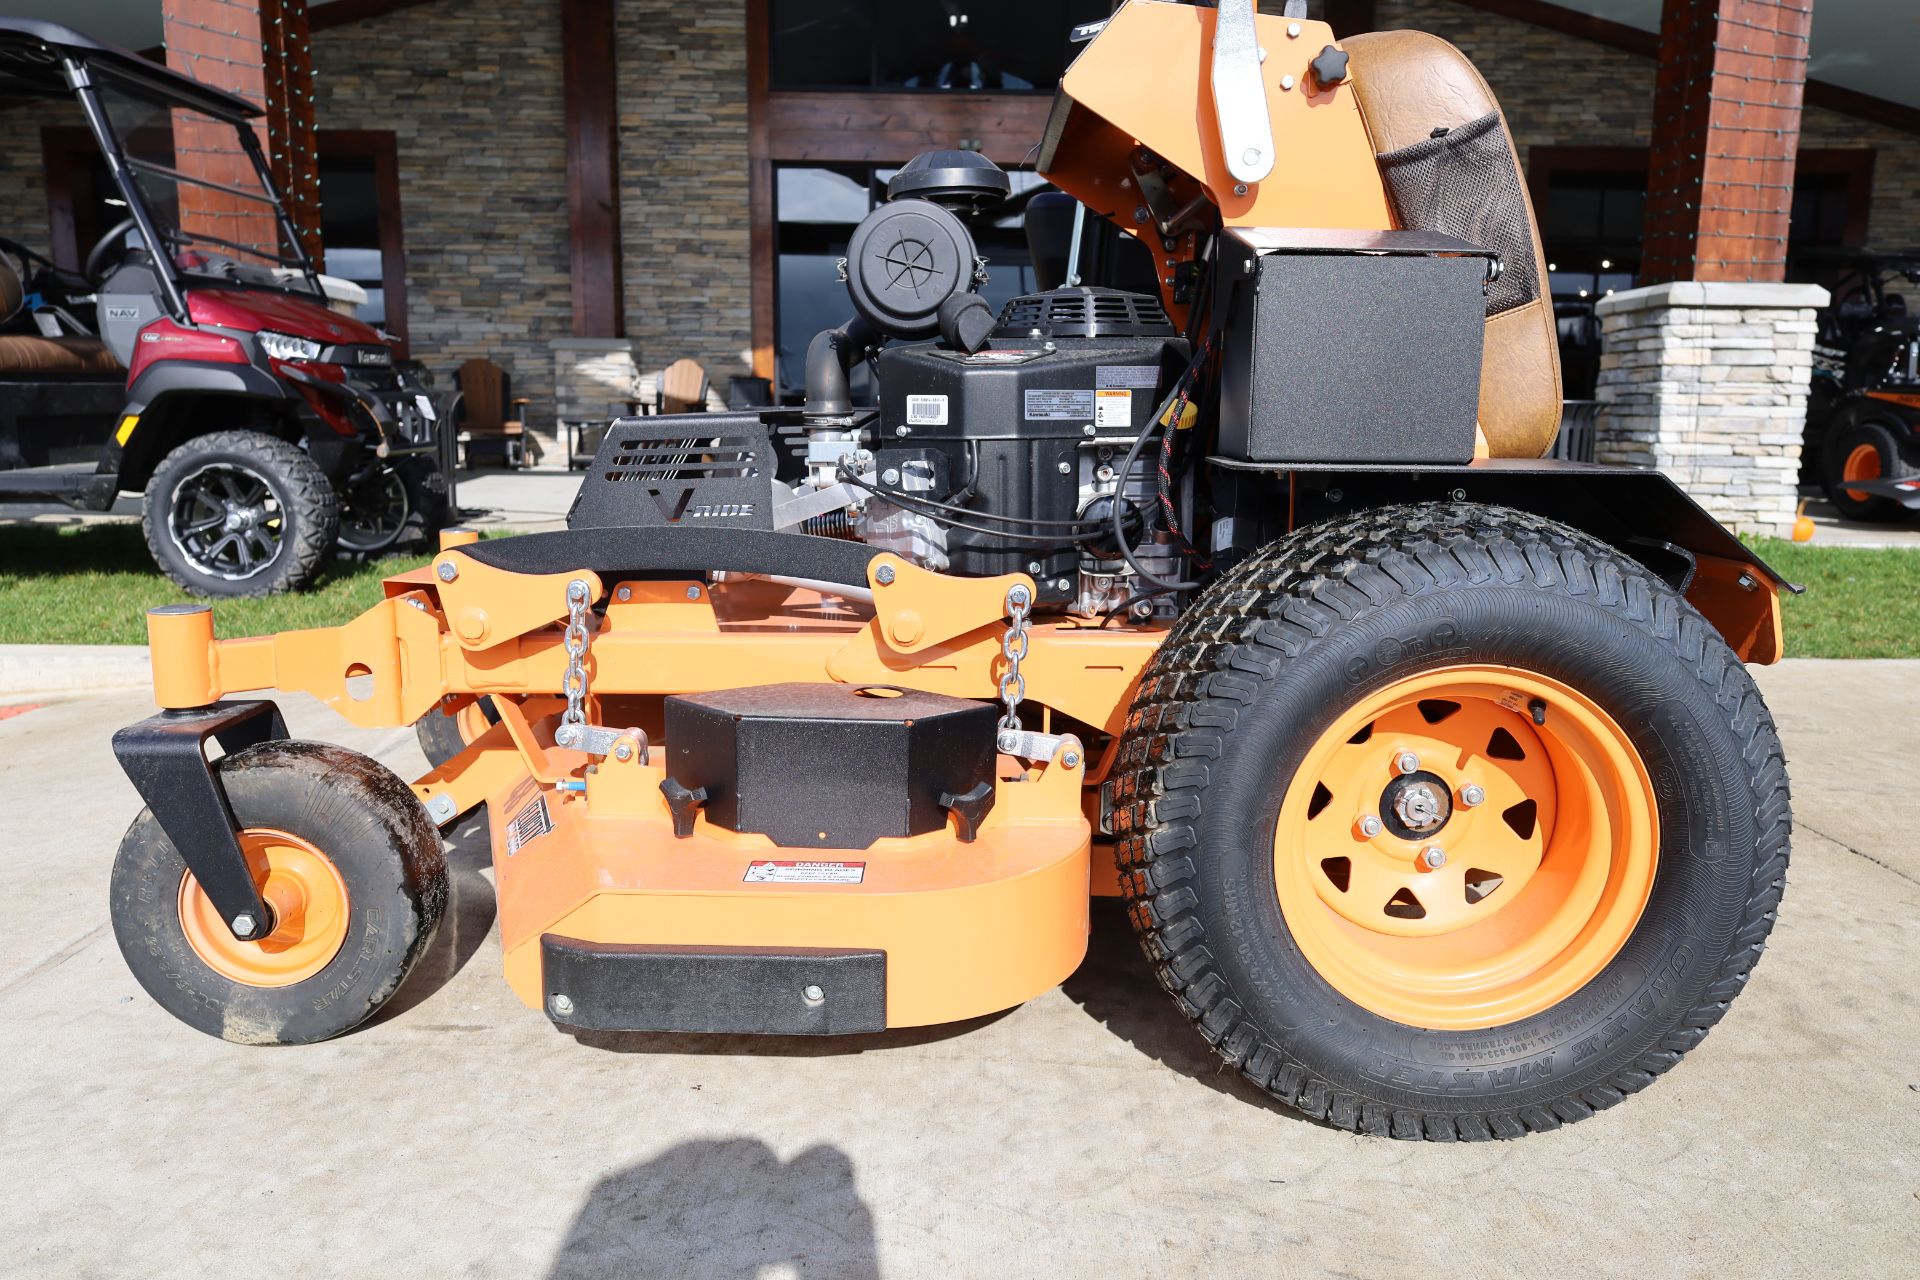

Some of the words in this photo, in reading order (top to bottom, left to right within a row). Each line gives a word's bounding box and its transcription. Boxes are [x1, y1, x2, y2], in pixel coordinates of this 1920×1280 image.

[109, 309, 137, 318] NAV
[1223, 878, 1239, 916] NHS
[1239, 864, 1251, 912] SERVICE
[1246, 916, 1268, 962] HIGHWAY
[312, 908, 379, 1011] CARLSTAR
[1565, 1002, 1605, 1033] SERVICE
[1571, 944, 1696, 1068] GRASS
[1541, 1026, 1563, 1046] CALL
[1366, 1058, 1552, 1091] MASTER
